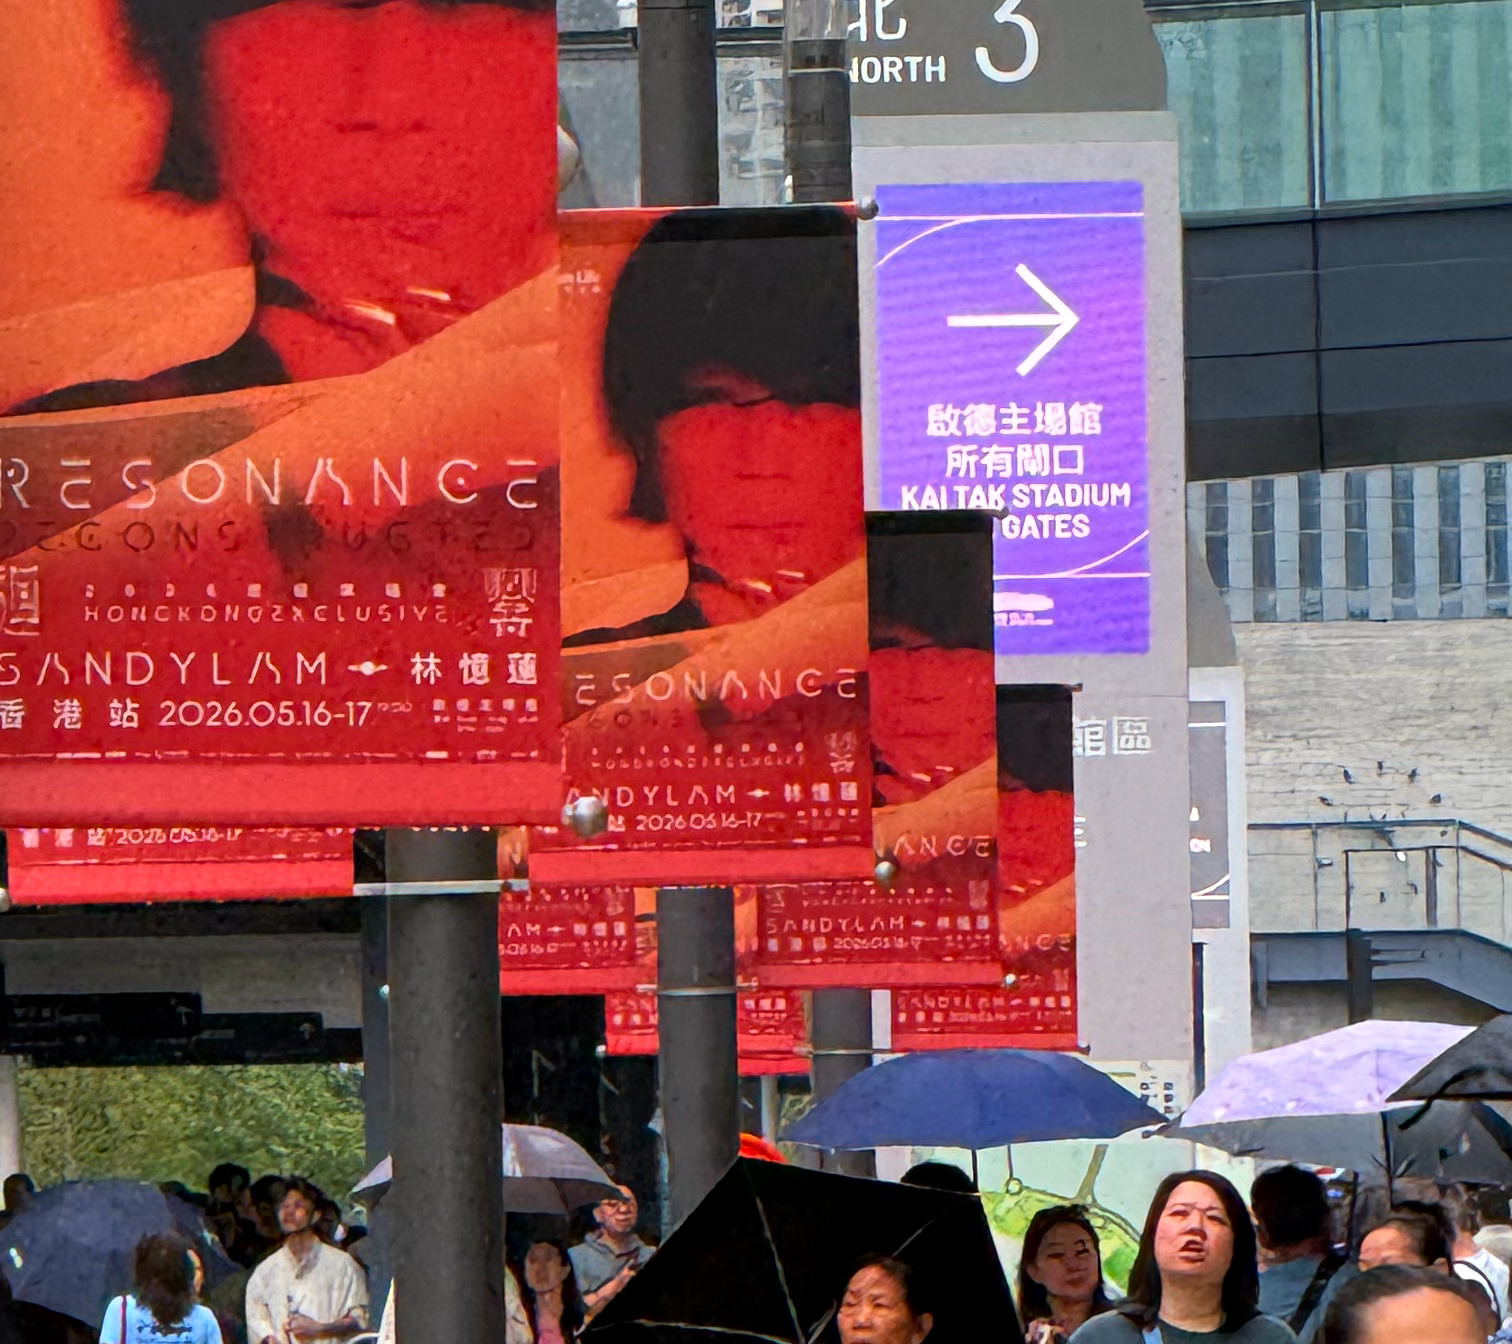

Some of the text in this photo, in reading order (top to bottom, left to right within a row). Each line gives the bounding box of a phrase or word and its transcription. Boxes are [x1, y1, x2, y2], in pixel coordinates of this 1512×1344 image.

[901, 482, 1132, 510] KAI TAK STADIUM
[1001, 513, 1091, 539] GATES
[575, 667, 856, 705] ESONANCE
[159, 700, 372, 728] 2026.05.16-17
